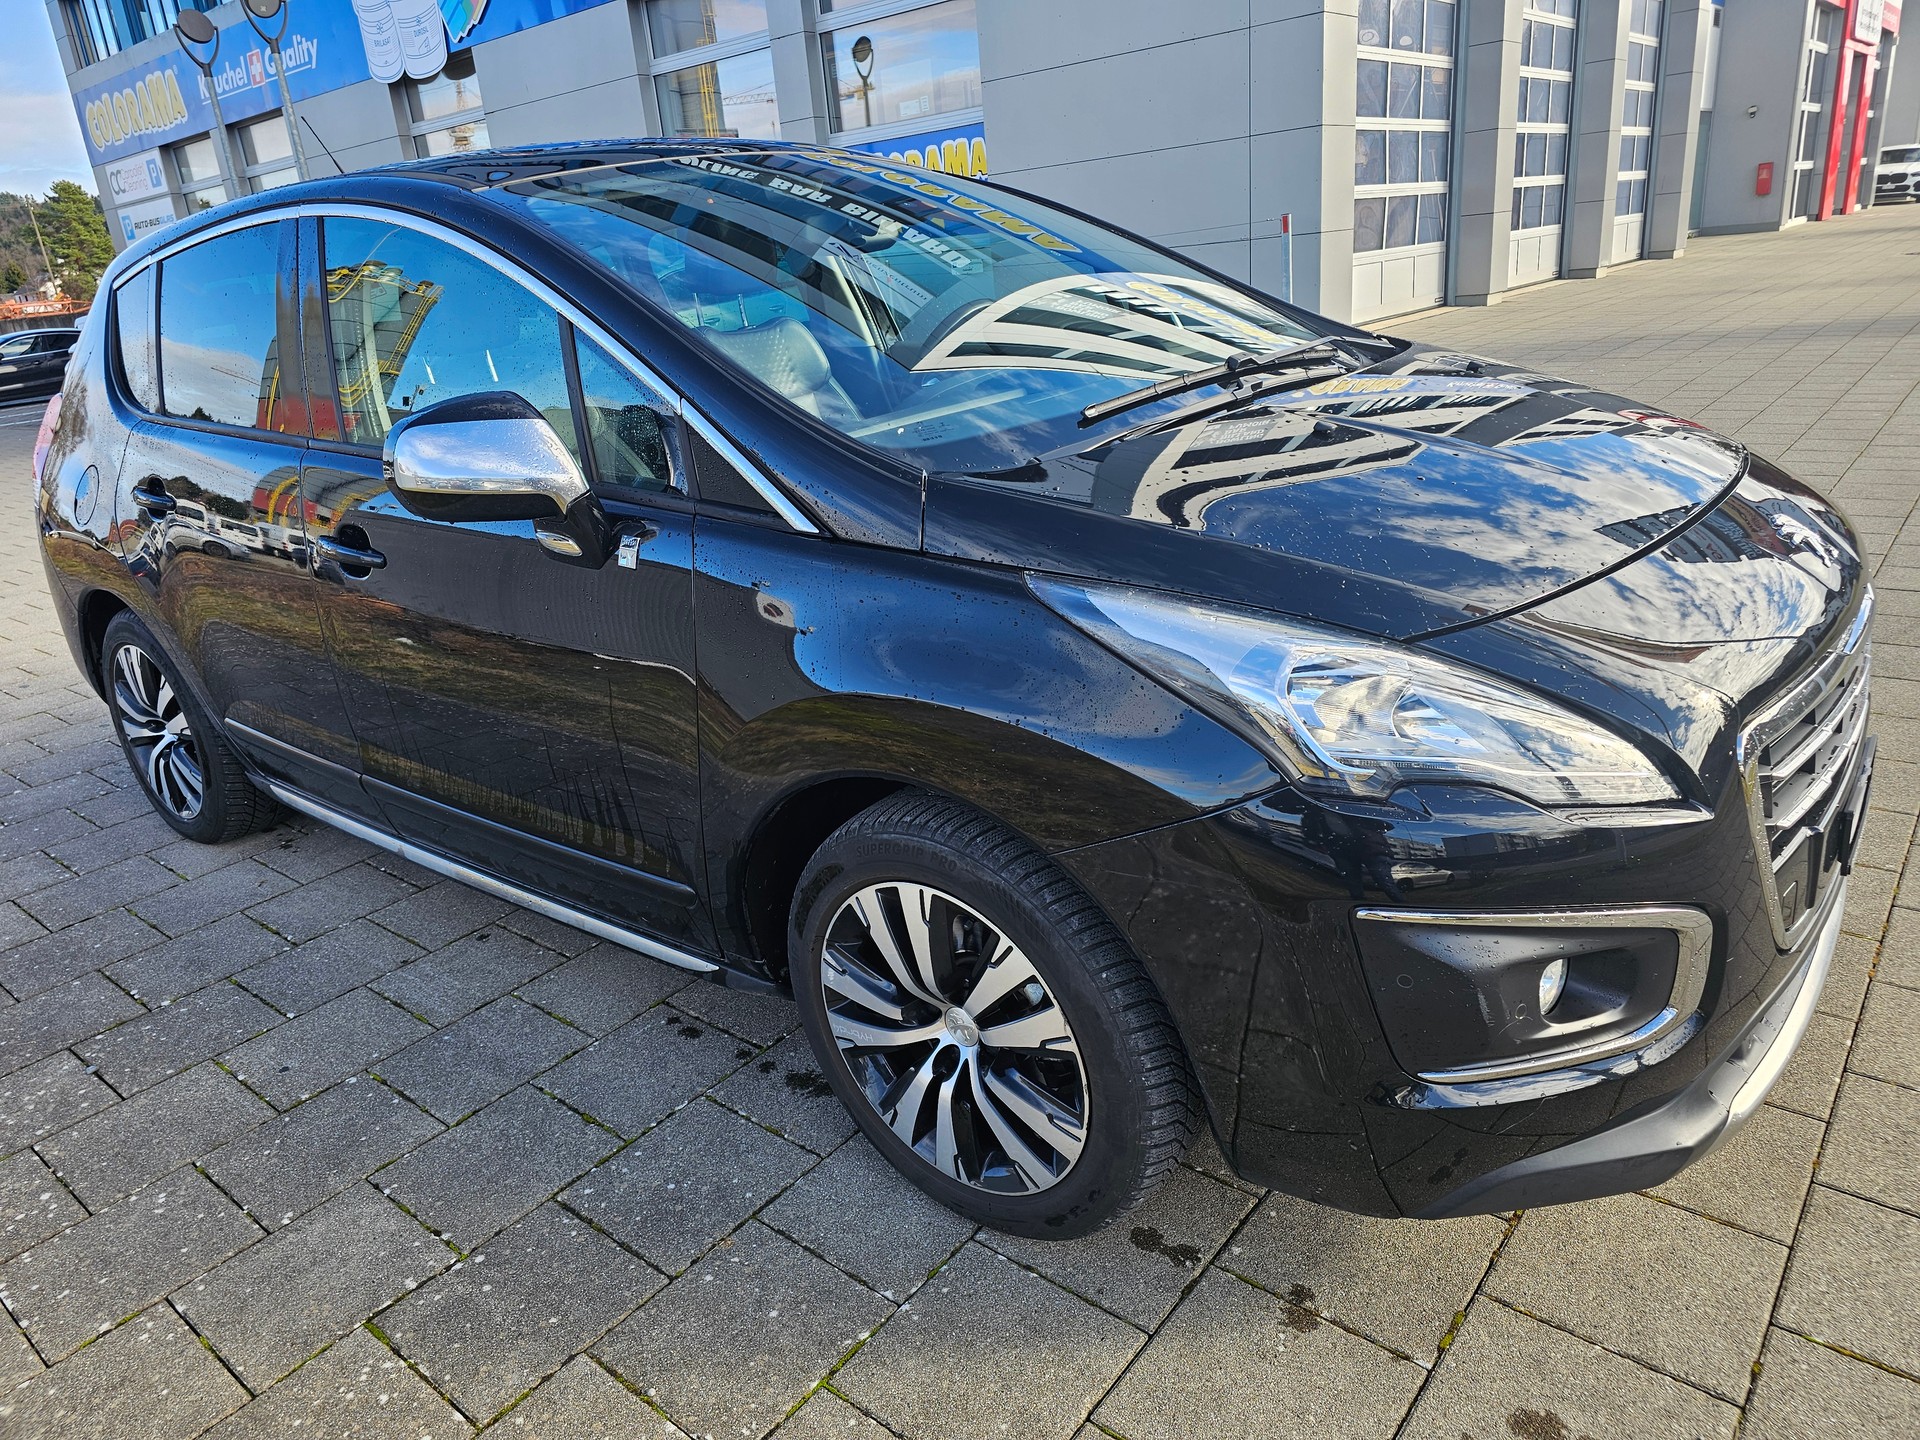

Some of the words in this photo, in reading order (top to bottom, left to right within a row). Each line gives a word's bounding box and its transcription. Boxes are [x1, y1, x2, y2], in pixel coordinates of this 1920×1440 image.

[197, 56, 248, 99] Kuchel
[86, 69, 188, 152] COLORAMA
[856, 841, 924, 858] SUPERGRIP
[929, 849, 958, 872] PRO
